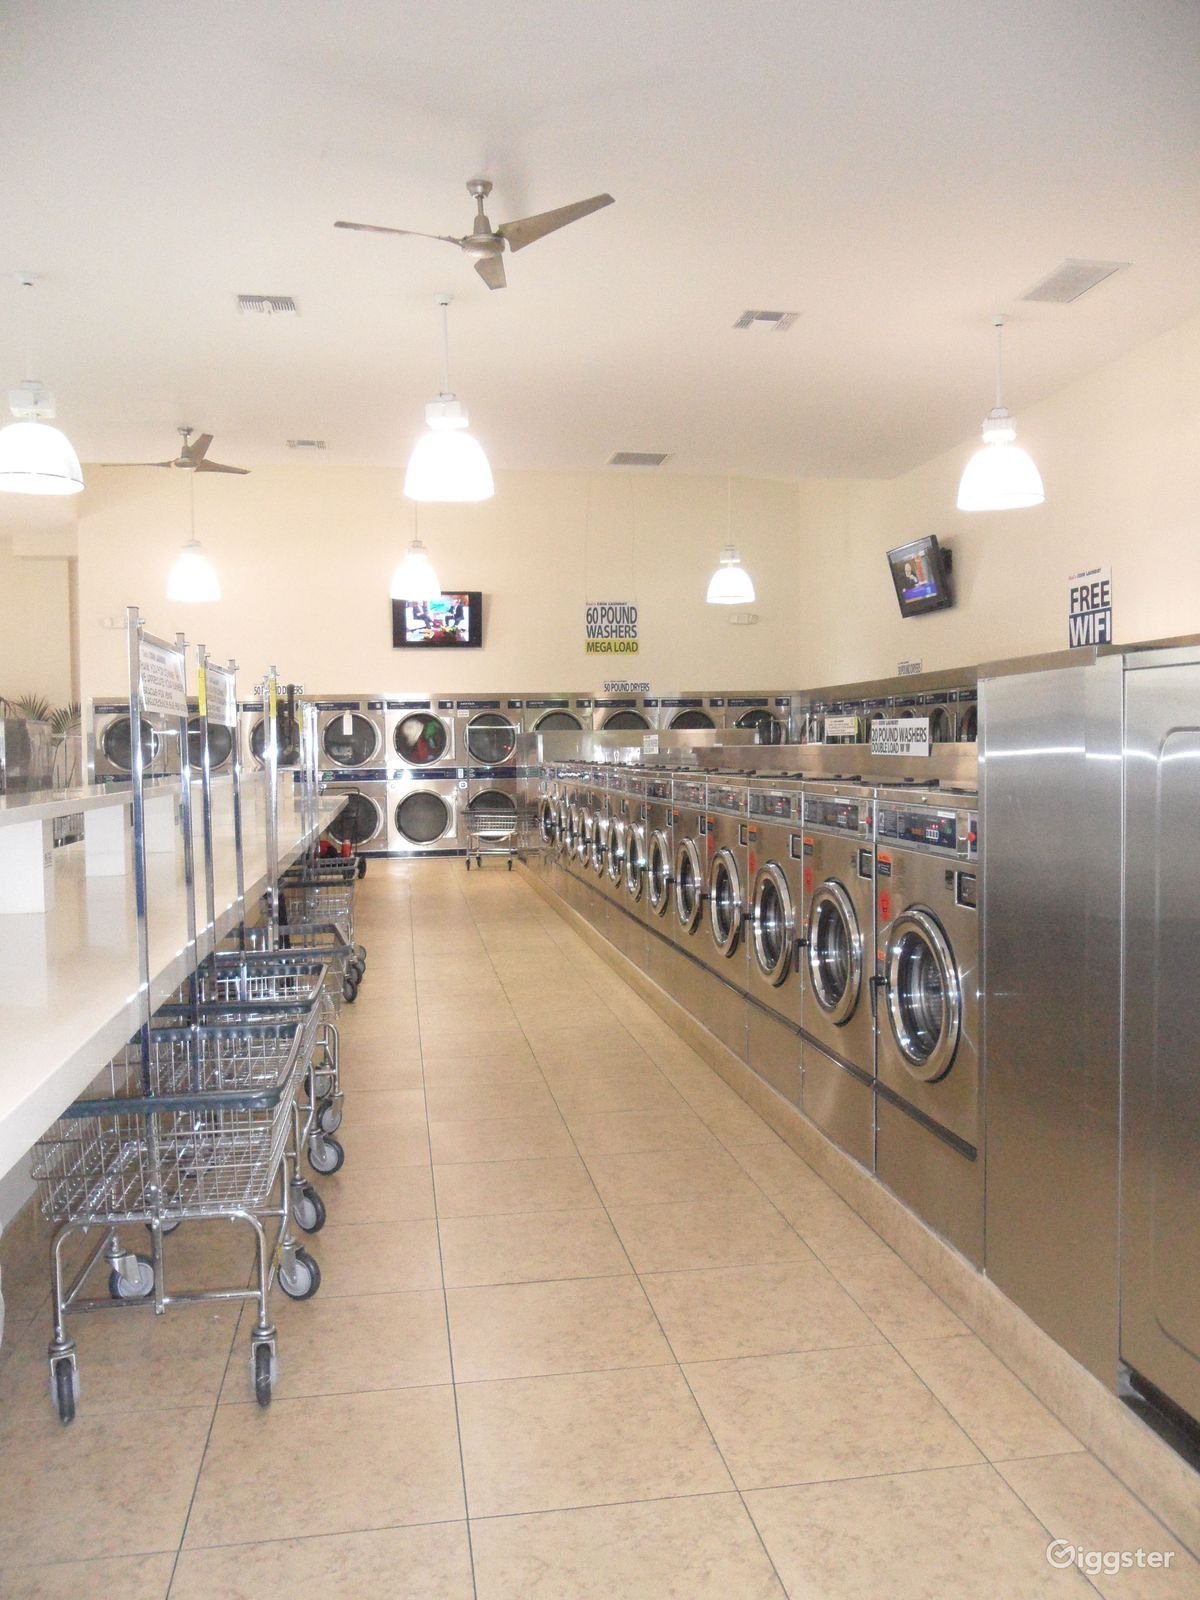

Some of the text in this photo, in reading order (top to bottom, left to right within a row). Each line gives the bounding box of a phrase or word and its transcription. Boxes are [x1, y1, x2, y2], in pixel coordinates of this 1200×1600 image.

[1070, 580, 1110, 613] FREE
[586, 606, 637, 624] 60 POUND
[586, 625, 637, 639] WASHERS
[1070, 610, 1110, 646] WIFI
[586, 641, 638, 652] MEGA LOAD
[254, 686, 261, 695] 50
[282, 685, 303, 695] DERS
[604, 682, 650, 692] 50 POUND DRYERS
[871, 728, 878, 742] 20
[878, 727, 898, 742] POUND
[899, 727, 927, 742] WASHERS
[872, 743, 899, 754] DOUBLE LOAD
